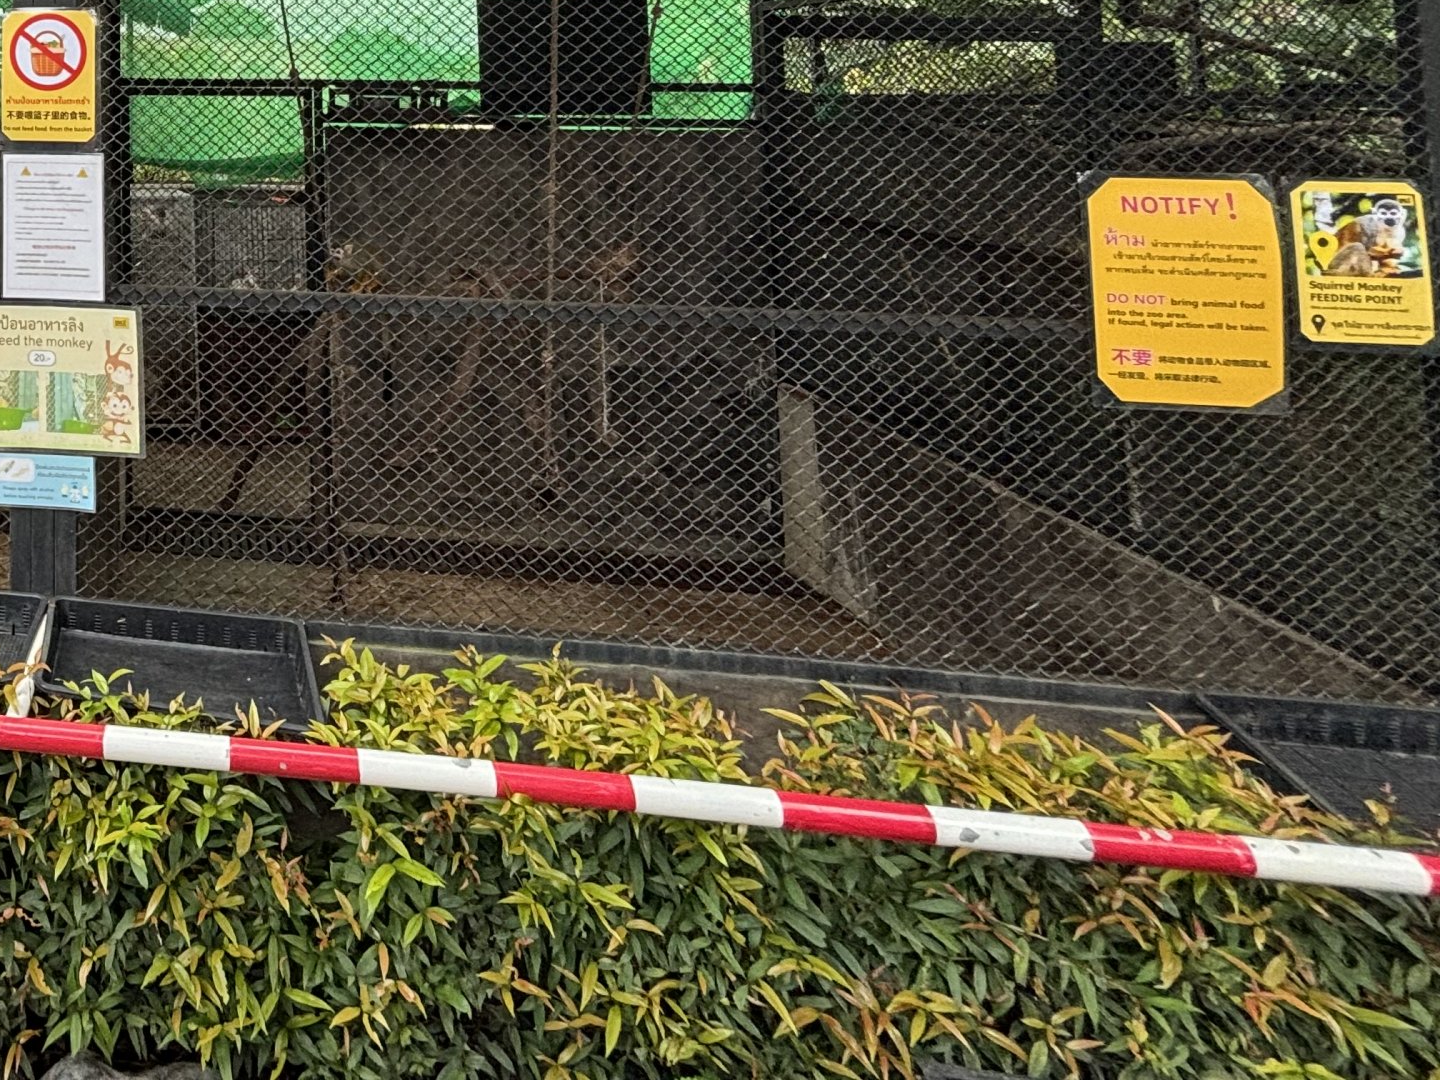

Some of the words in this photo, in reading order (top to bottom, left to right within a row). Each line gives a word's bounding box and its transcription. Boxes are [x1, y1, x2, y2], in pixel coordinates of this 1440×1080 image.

[1103, 227, 1145, 247] ห้าม
[1309, 280, 1354, 291] Squirrel
[1357, 282, 1403, 294] Monkey
[1106, 293, 1129, 303] DO
[1134, 294, 1166, 305] NOT
[1170, 297, 1199, 310] bring
[1201, 299, 1237, 309] animal
[1240, 300, 1265, 310] food
[1310, 293, 1362, 303] FEEDING
[1365, 294, 1403, 305] POINT
[1129, 309, 1144, 317] the
[0, 314, 84, 332] ป้อนอาหารลิง
[1150, 320, 1173, 329] legal
[1175, 321, 1204, 329] action
[1207, 322, 1224, 330] will
[1240, 323, 1269, 332] taken.
[24, 335, 43, 346] the
[46, 337, 93, 351] monkey
[1111, 348, 1152, 366] 不要
